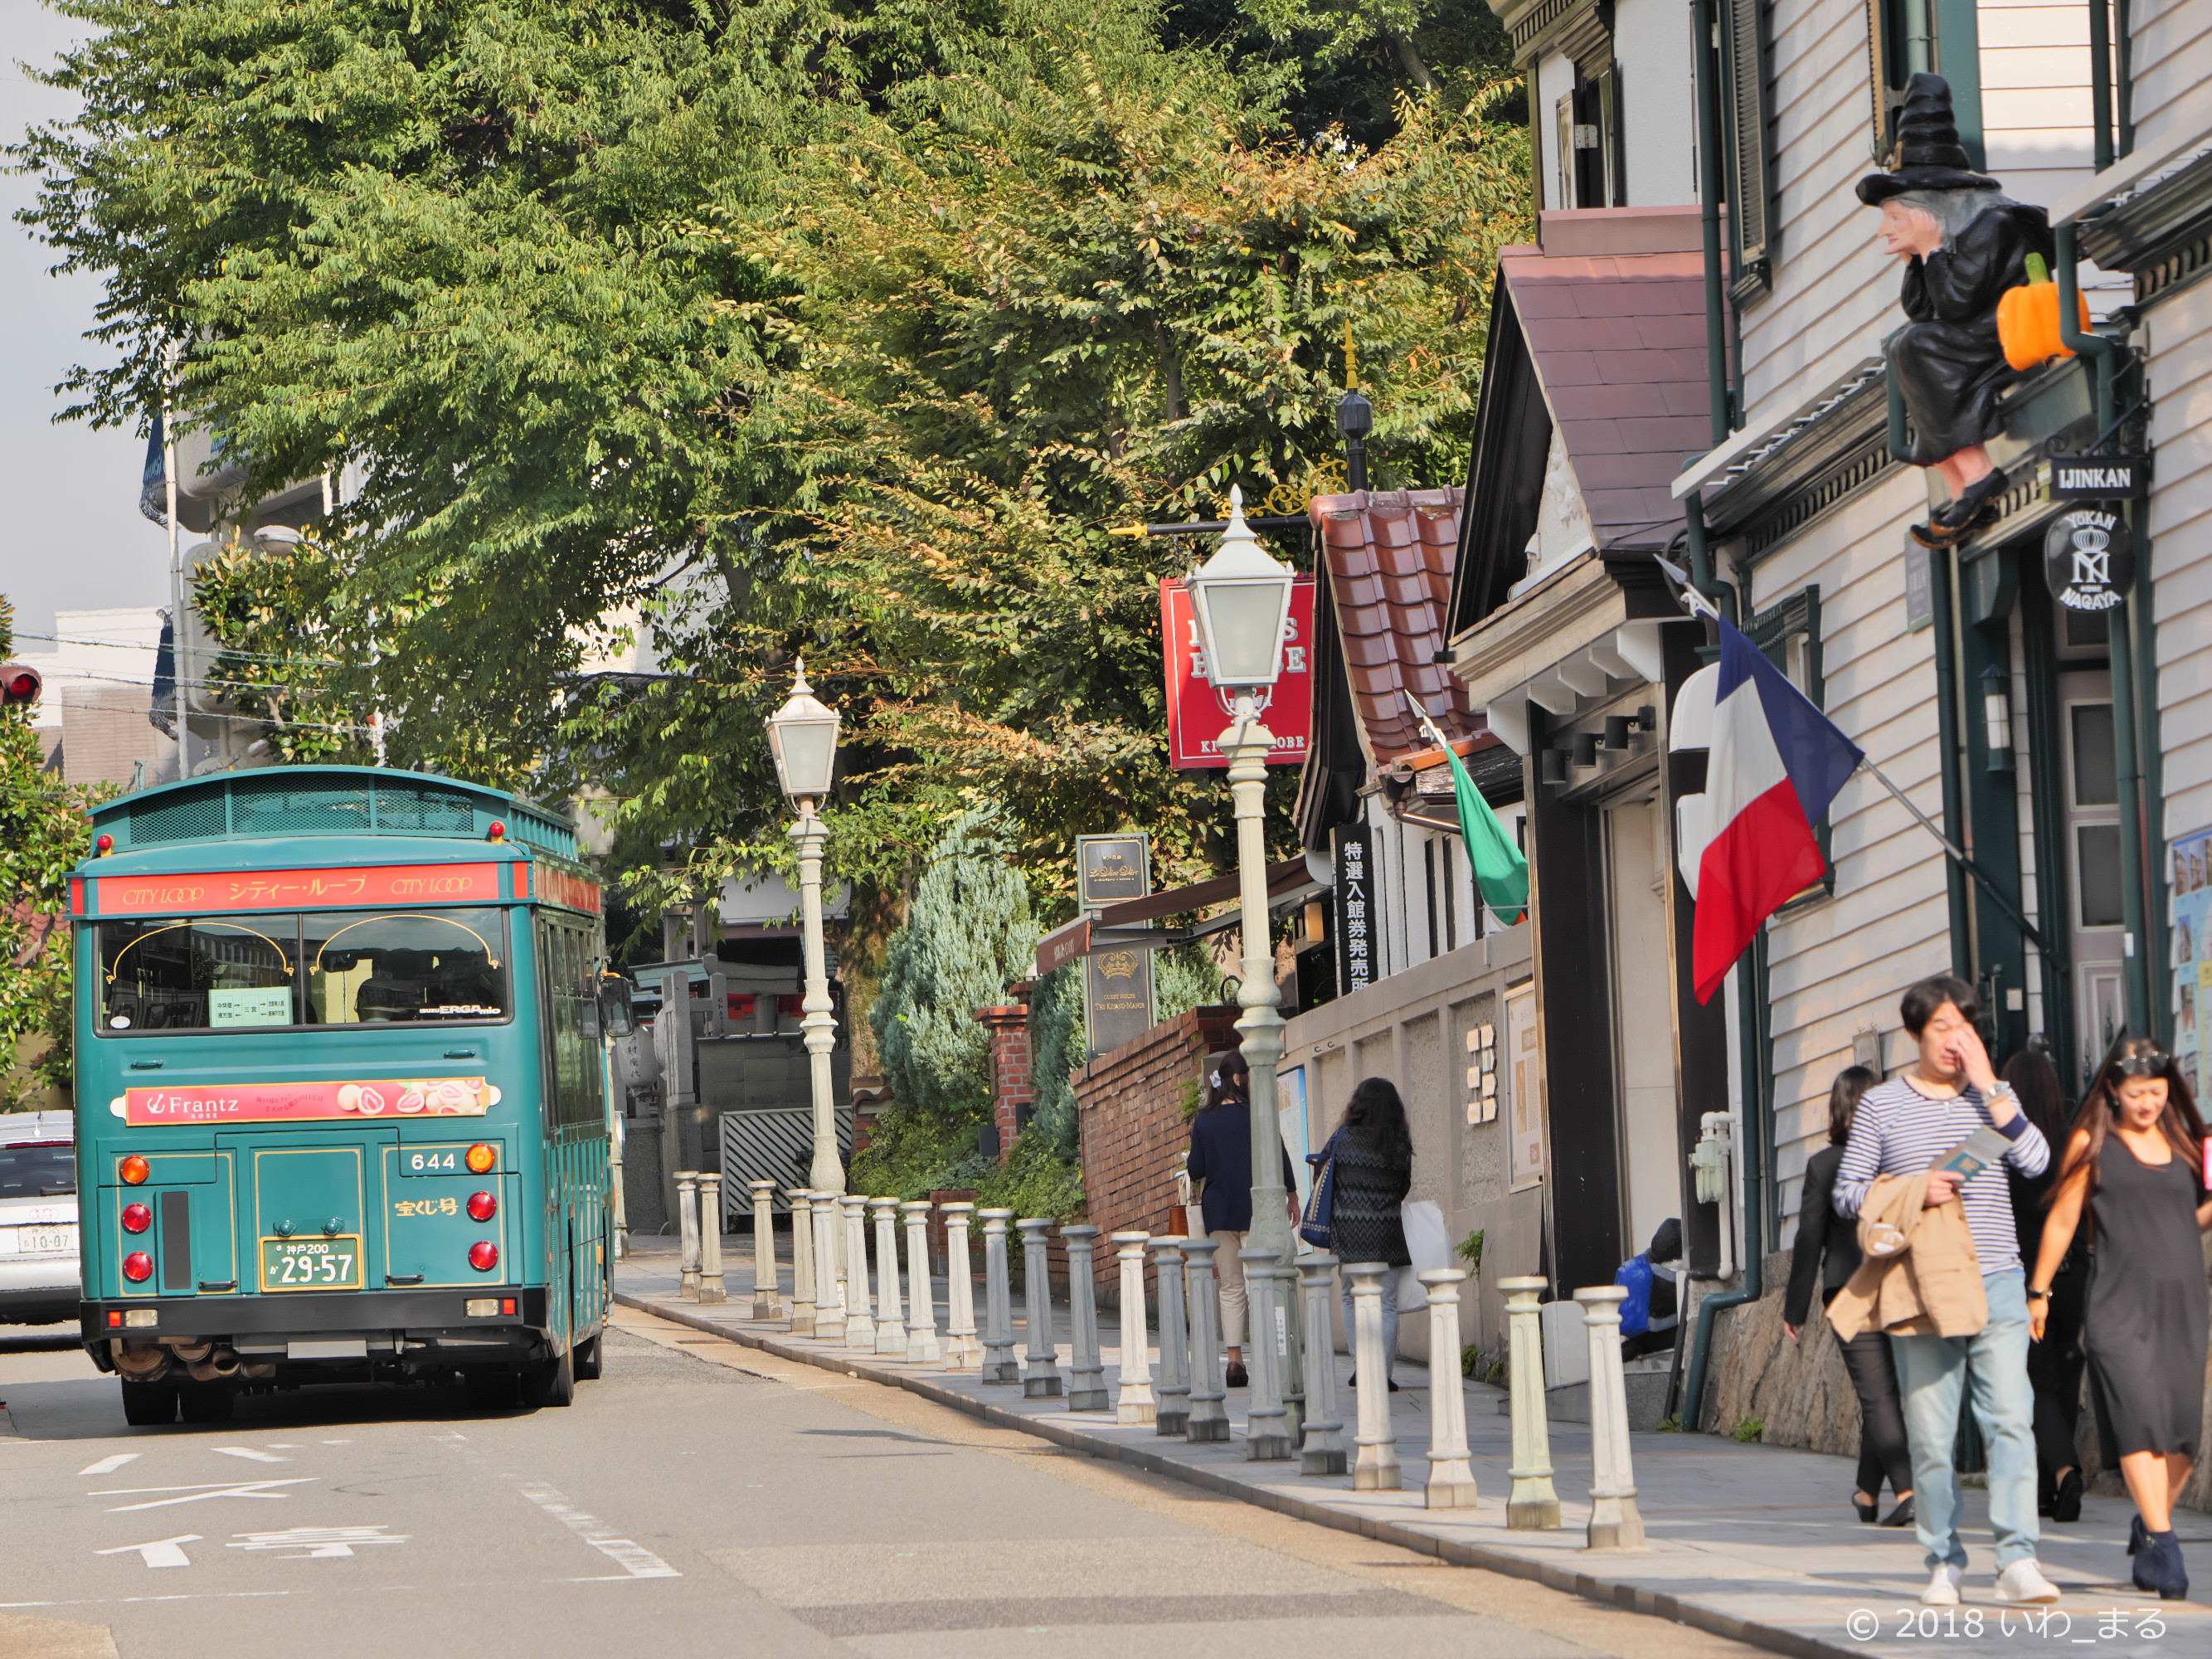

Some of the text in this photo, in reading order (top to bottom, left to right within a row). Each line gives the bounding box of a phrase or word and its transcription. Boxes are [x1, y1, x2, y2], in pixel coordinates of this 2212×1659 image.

[2058, 468, 2131, 489] IJINKAN
[2060, 586, 2122, 610] NAGAYA
[1268, 736, 1305, 750] OBE
[230, 873, 367, 901] シティー・ループ
[391, 877, 473, 895] CITY LOOP
[123, 887, 204, 905] CITY LOOP
[1344, 841, 1369, 992] 特選入館券発売所
[479, 1006, 501, 1014] mio
[169, 1097, 239, 1113] Frantz
[411, 1152, 455, 1170] 644
[394, 1197, 459, 1217] 宝くじ号
[33, 1235, 68, 1248] 10-07
[286, 1244, 329, 1255] 神戸200
[270, 1254, 352, 1283] か 29-57
